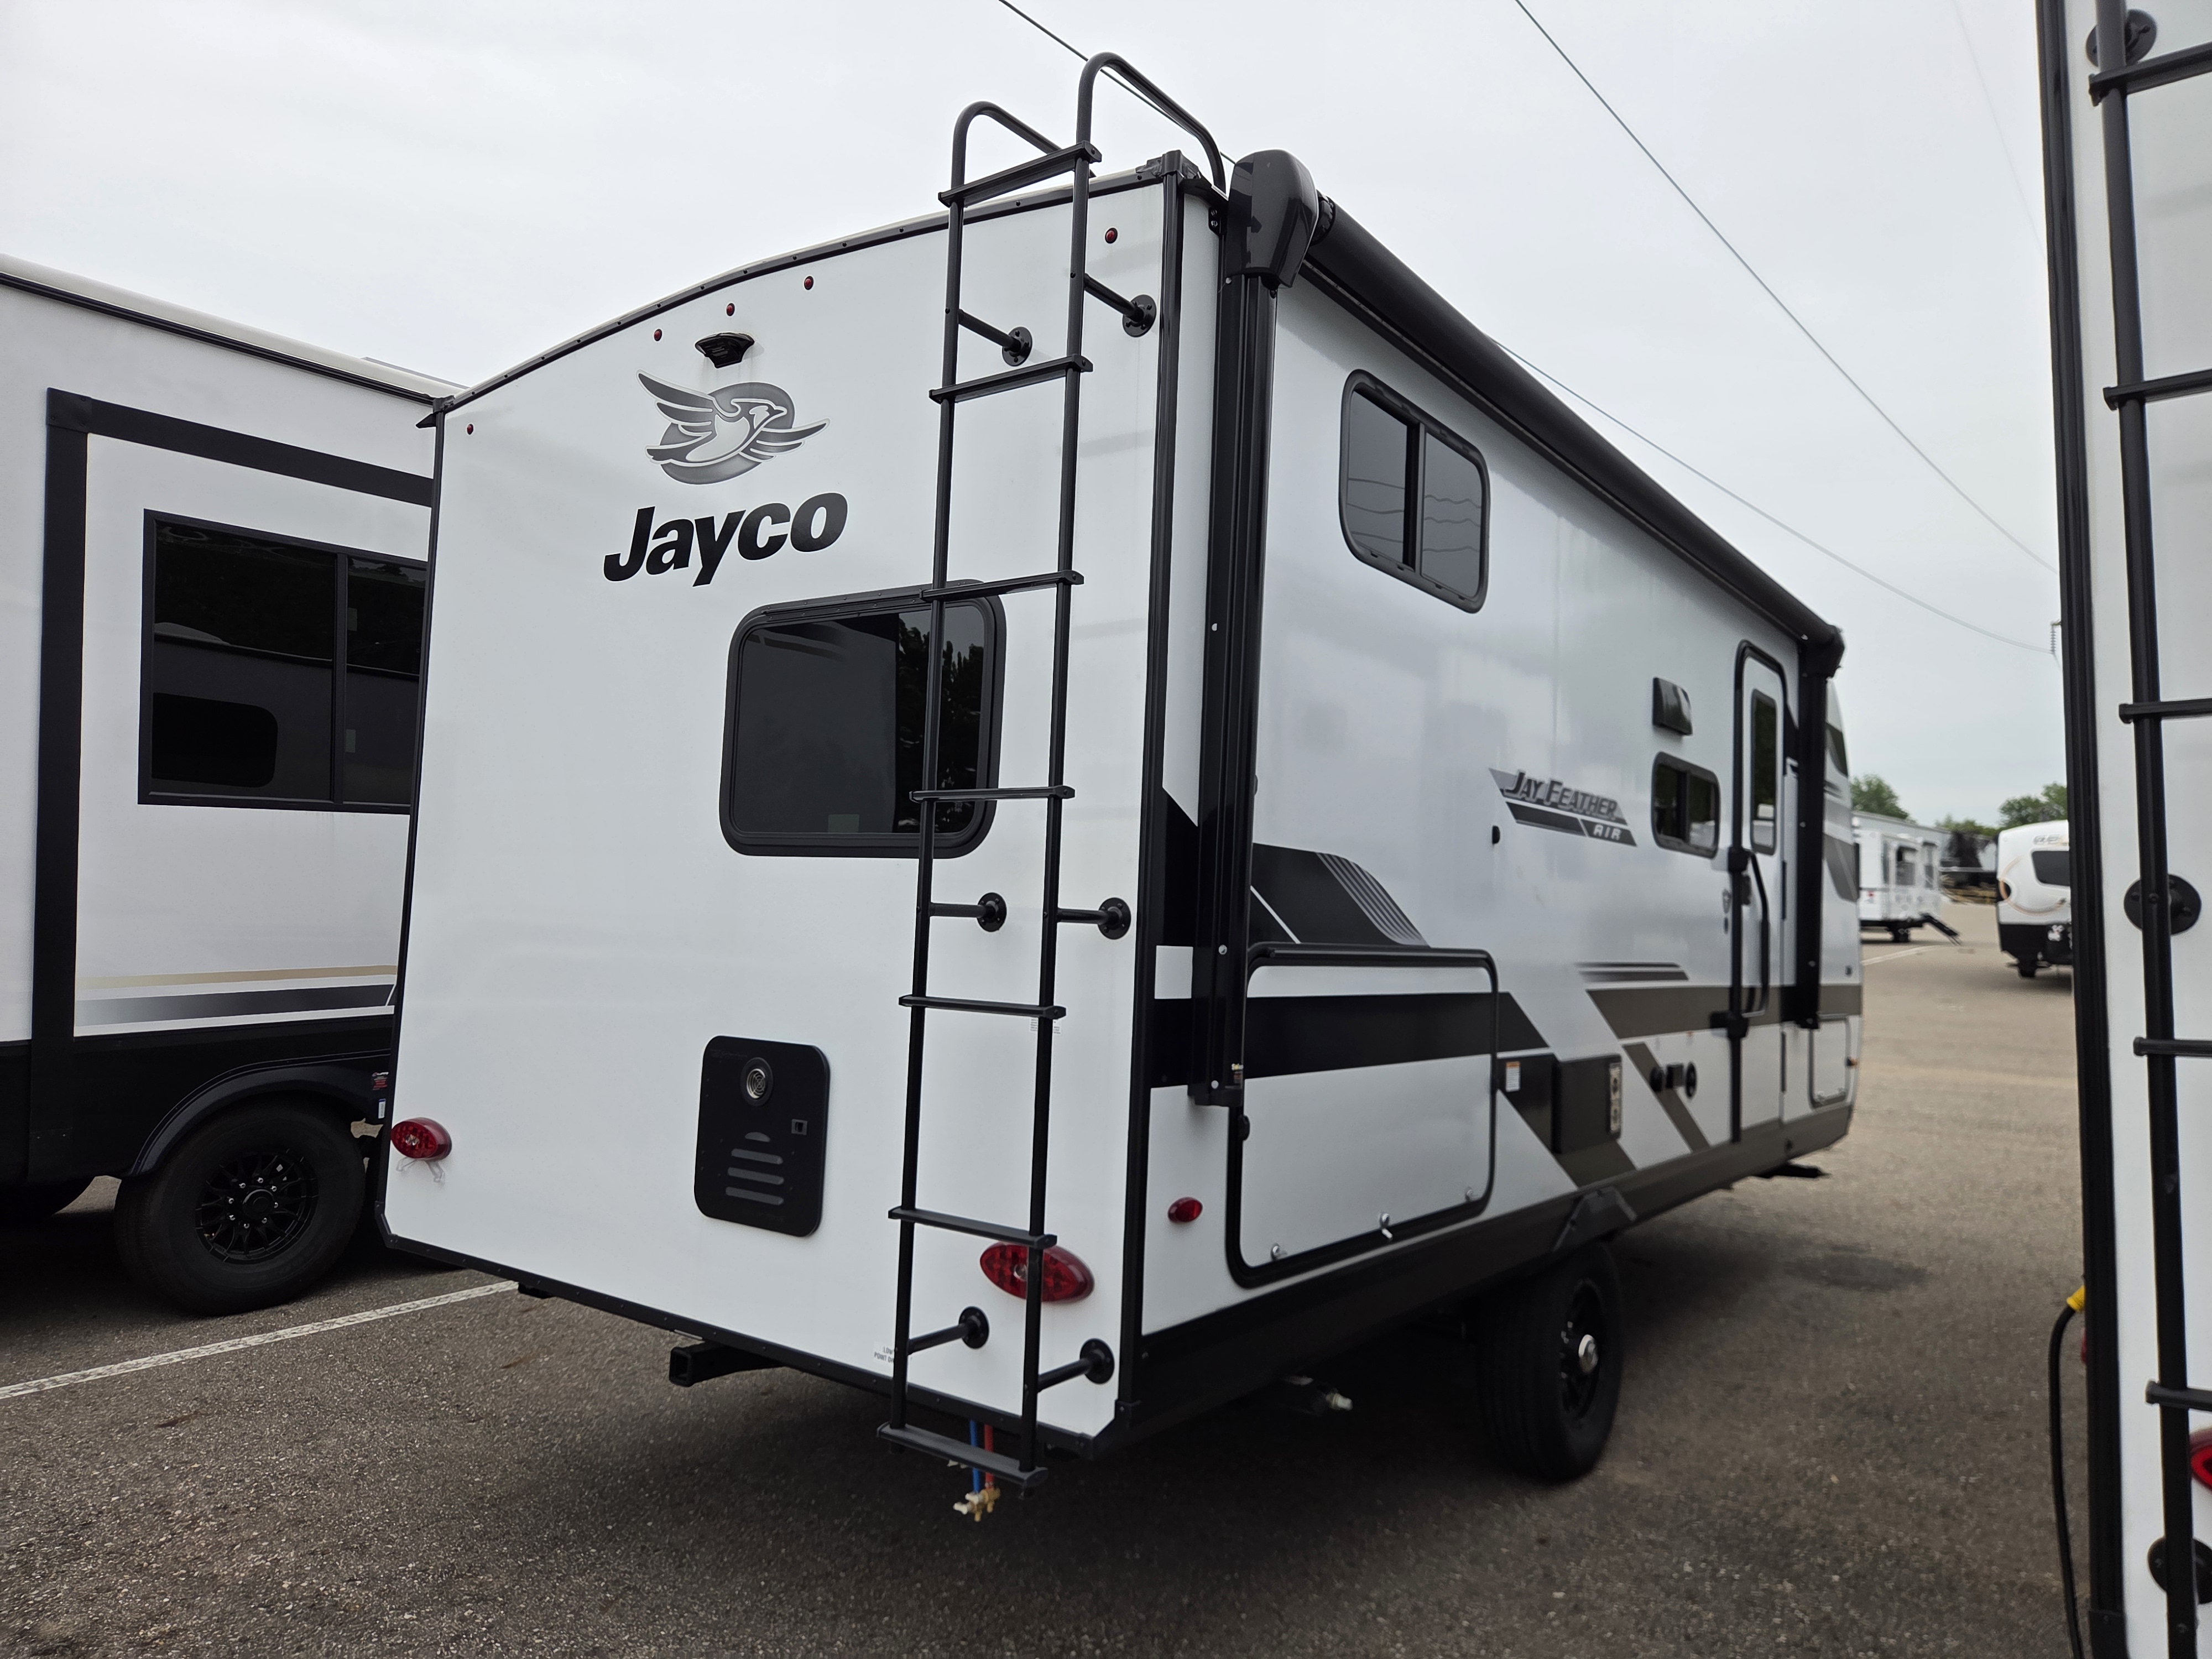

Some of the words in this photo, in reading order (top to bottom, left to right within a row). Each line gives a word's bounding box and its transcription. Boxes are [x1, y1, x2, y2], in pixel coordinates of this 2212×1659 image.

[603, 492, 848, 586] Jayco
[1546, 779, 1618, 818] FEATHER
[1593, 824, 1621, 841] AIR
